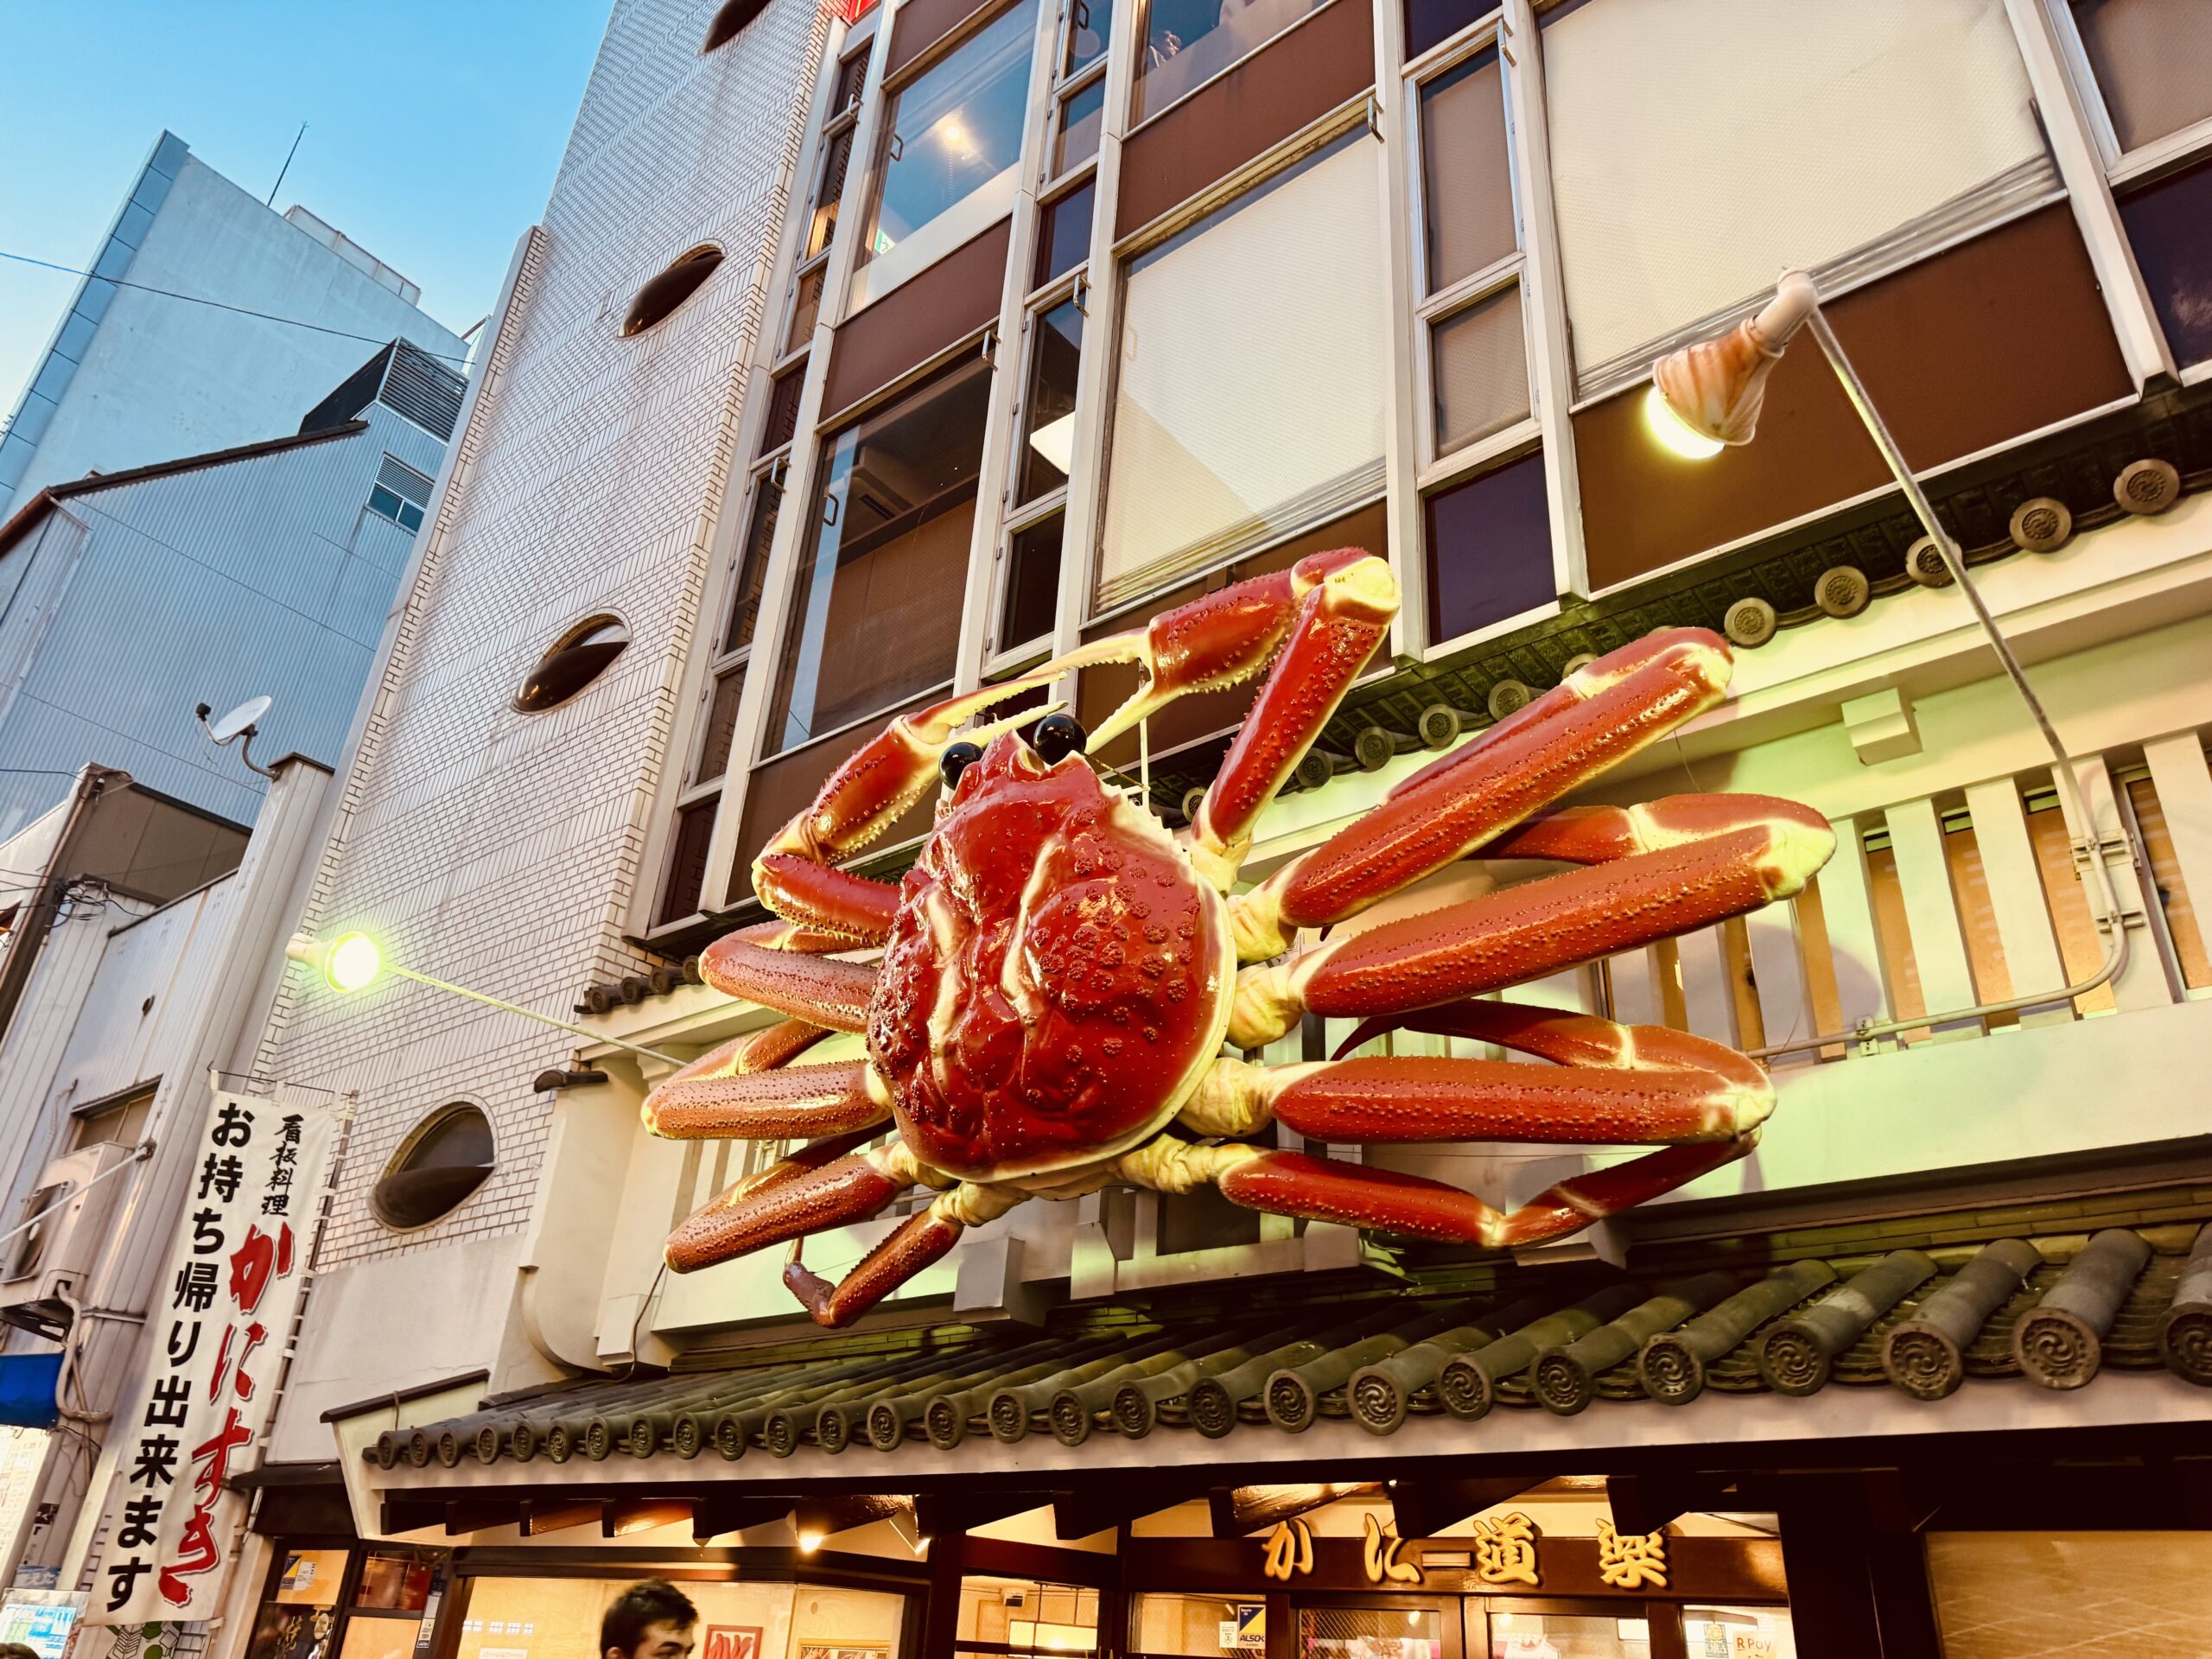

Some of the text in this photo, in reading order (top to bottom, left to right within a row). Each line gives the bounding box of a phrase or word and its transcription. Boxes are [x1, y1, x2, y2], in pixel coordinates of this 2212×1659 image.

[261, 1114, 304, 1216] 看板料理
[107, 1102, 255, 1612] お持ち帰り出来ます
[158, 1223, 295, 1609] かにすき
[1239, 1634, 1265, 1643] ALSOK
